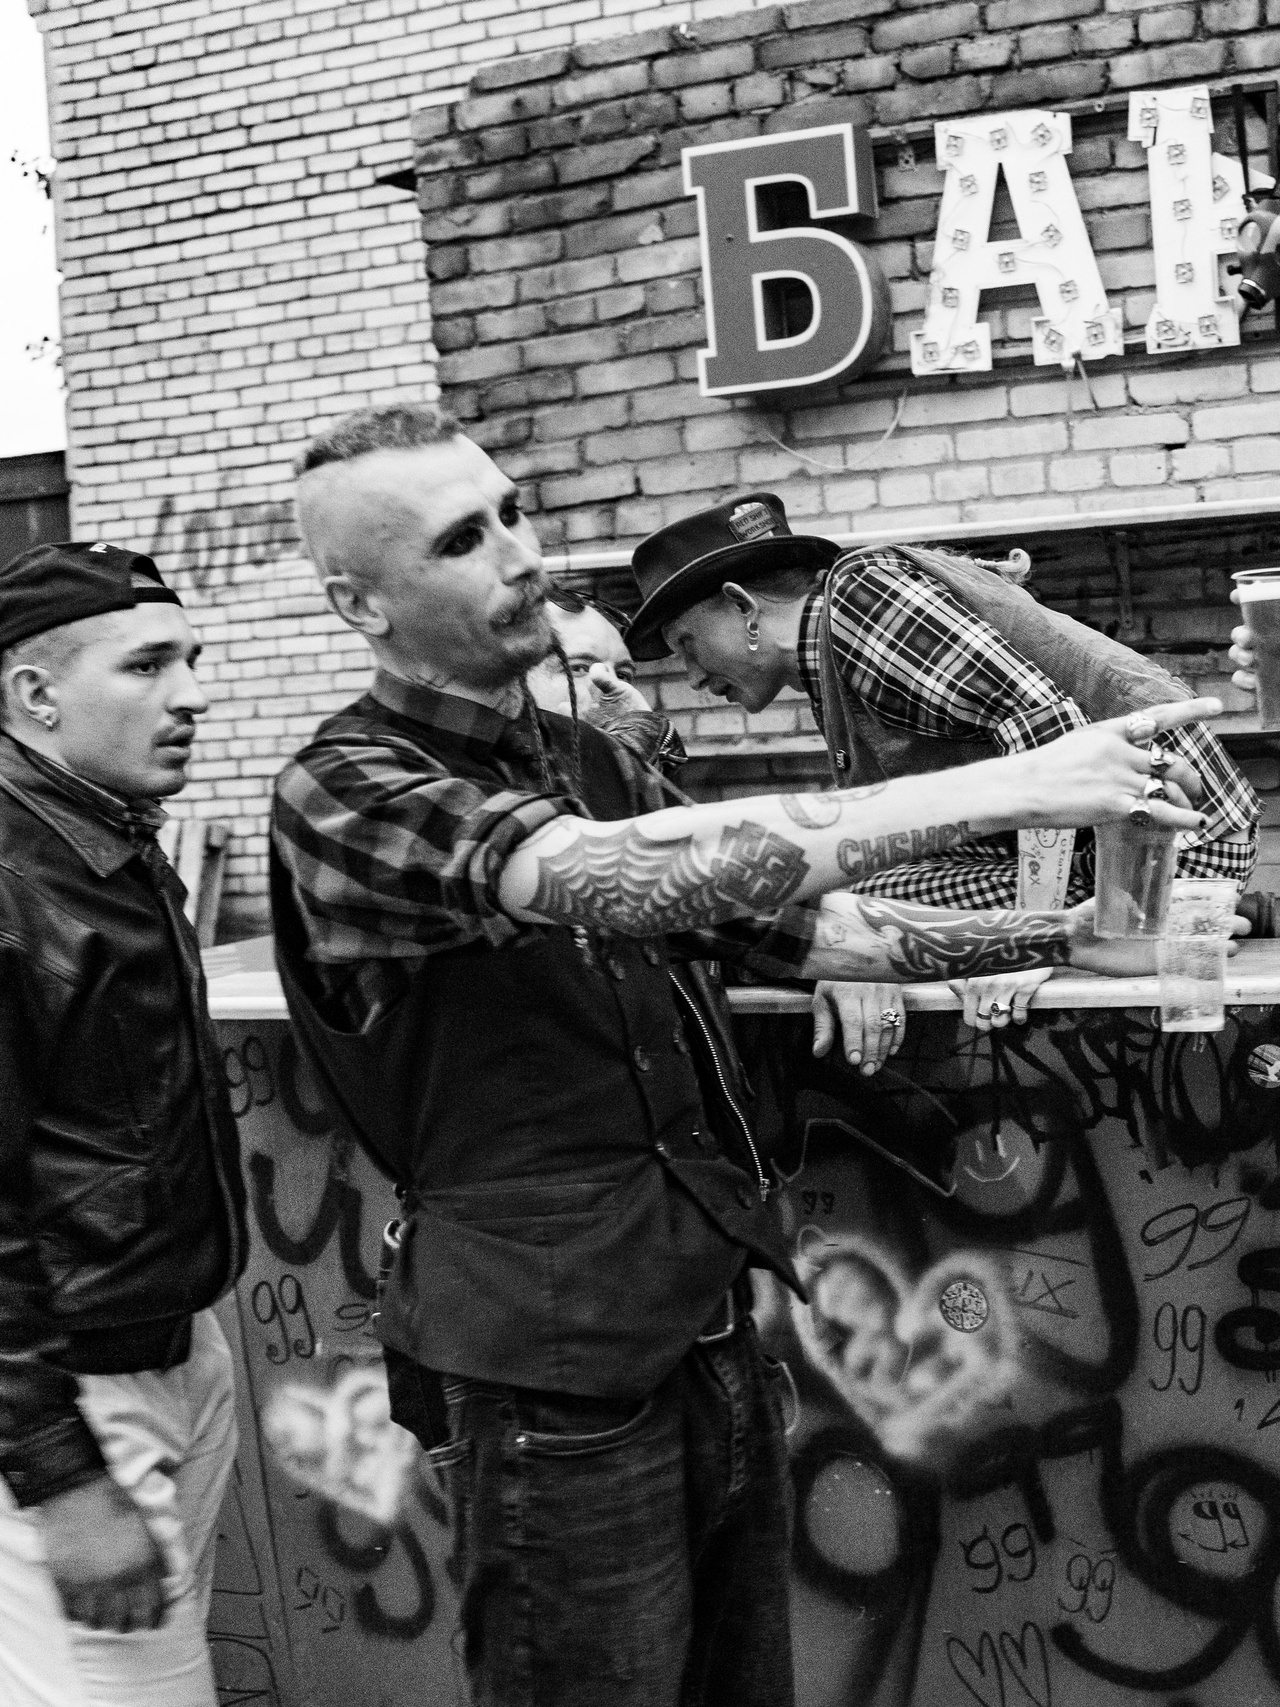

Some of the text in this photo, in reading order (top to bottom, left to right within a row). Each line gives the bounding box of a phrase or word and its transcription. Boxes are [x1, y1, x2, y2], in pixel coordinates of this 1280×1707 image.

[1140, 1196, 1252, 1282] 99
[252, 1274, 316, 1365] 99
[1149, 1302, 1207, 1396] 99
[959, 1523, 1038, 1595] 99
